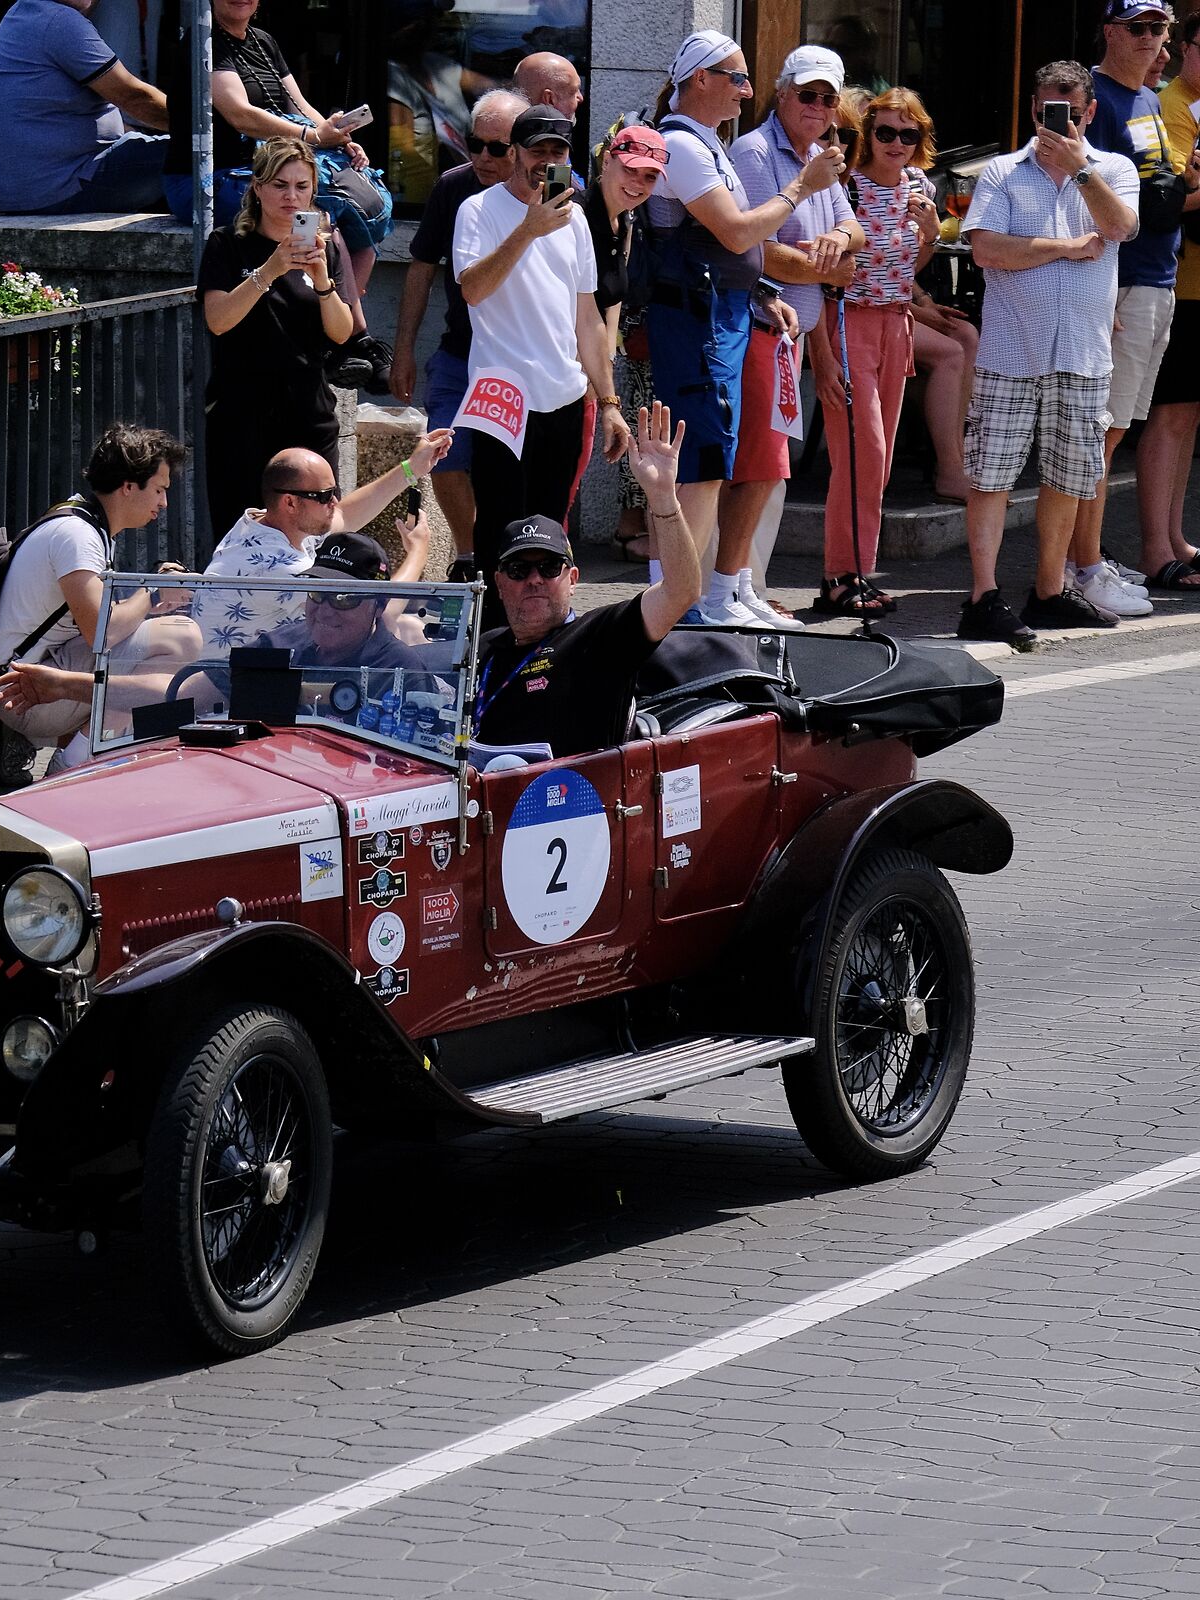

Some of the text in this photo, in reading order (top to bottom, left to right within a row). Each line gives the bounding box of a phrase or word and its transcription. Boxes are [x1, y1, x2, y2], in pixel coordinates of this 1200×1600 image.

[479, 381, 521, 410] 1000
[466, 399, 518, 433] MIGLIA
[547, 789, 560, 801] 1000
[547, 797, 566, 807] MIGLIA
[372, 795, 451, 825] Maggi Davide
[286, 827, 313, 838] classic
[309, 850, 333, 864] 2022
[365, 850, 398, 860] CHOPARD
[545, 837, 568, 894] 2
[309, 872, 334, 880] MIGLIA
[366, 889, 399, 900] CHOPARD
[428, 897, 449, 908] 1000
[426, 908, 451, 920] MIGLIA
[534, 910, 558, 919] CHOPARD
[374, 986, 402, 997] HOPARD
